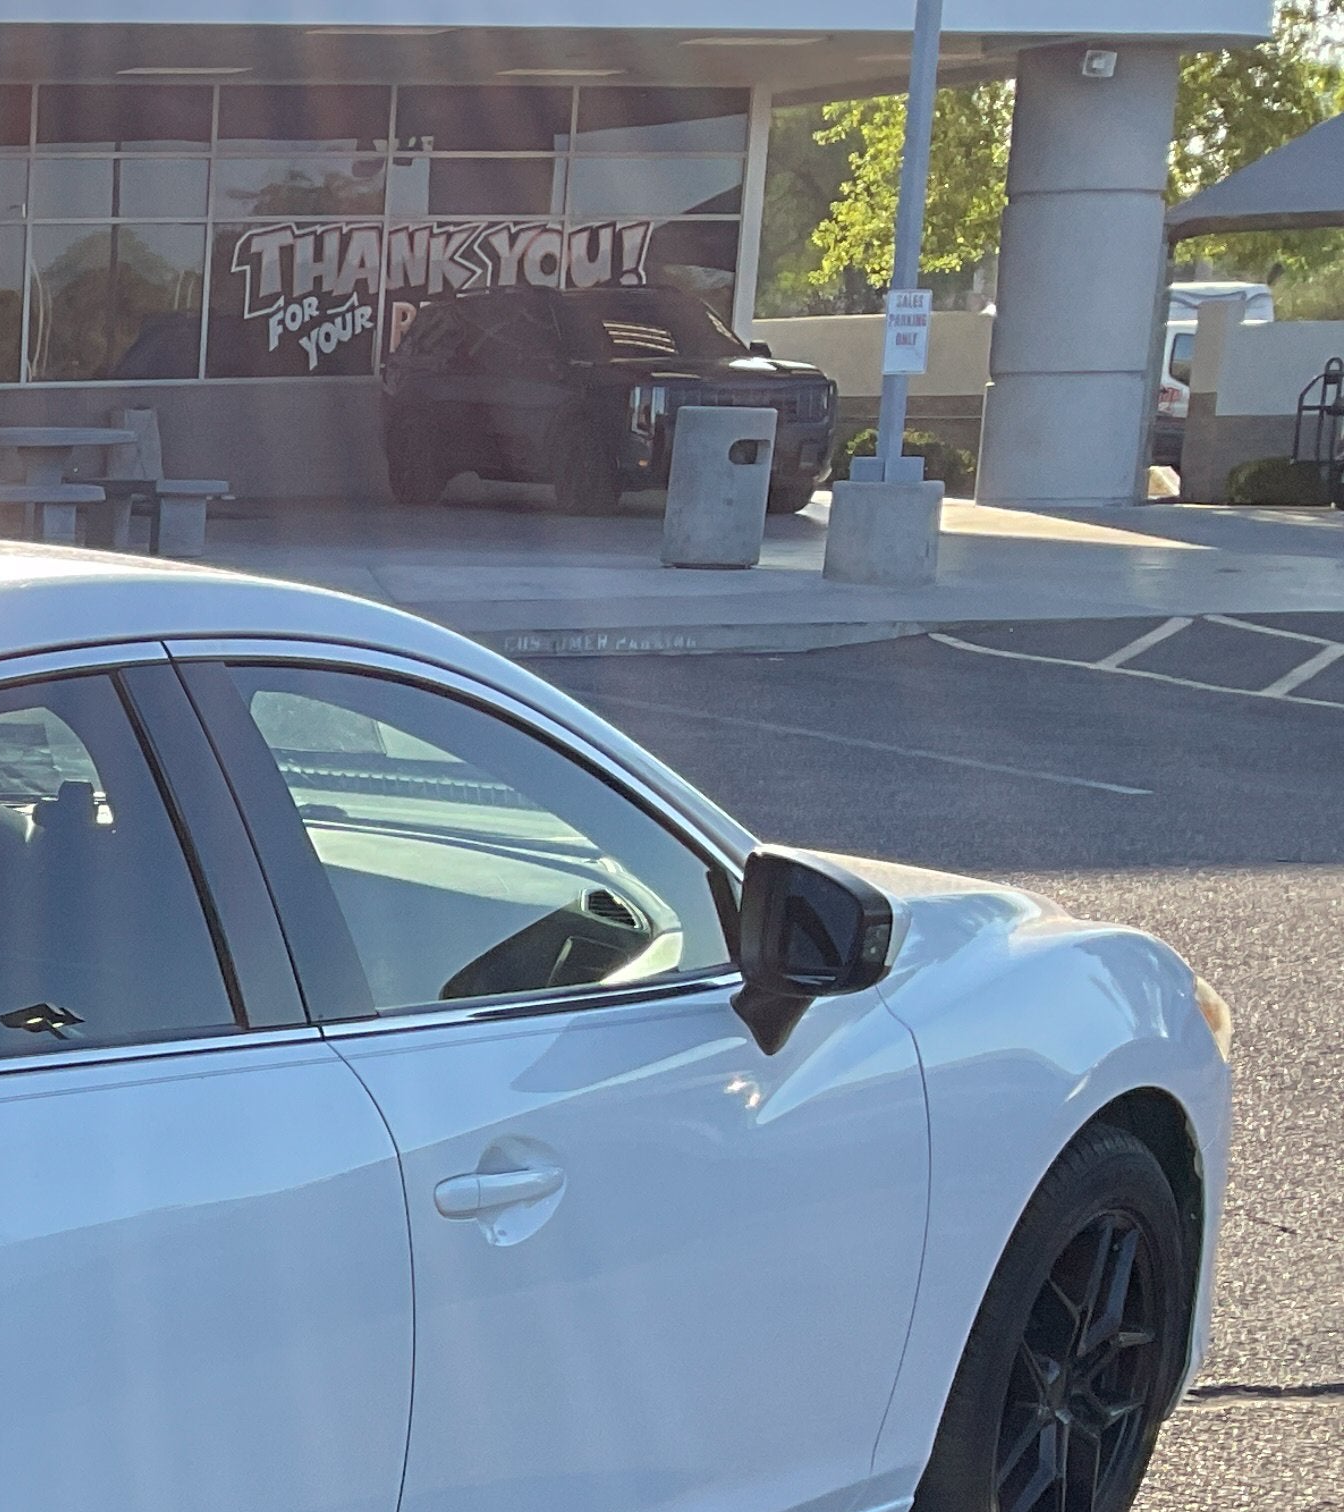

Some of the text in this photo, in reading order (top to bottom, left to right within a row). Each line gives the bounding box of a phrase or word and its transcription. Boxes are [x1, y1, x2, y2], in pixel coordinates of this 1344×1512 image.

[250, 222, 649, 298] THANK YOU!
[268, 296, 320, 352] FOR
[299, 304, 374, 371] YOUR
[888, 314, 926, 327] PARKING
